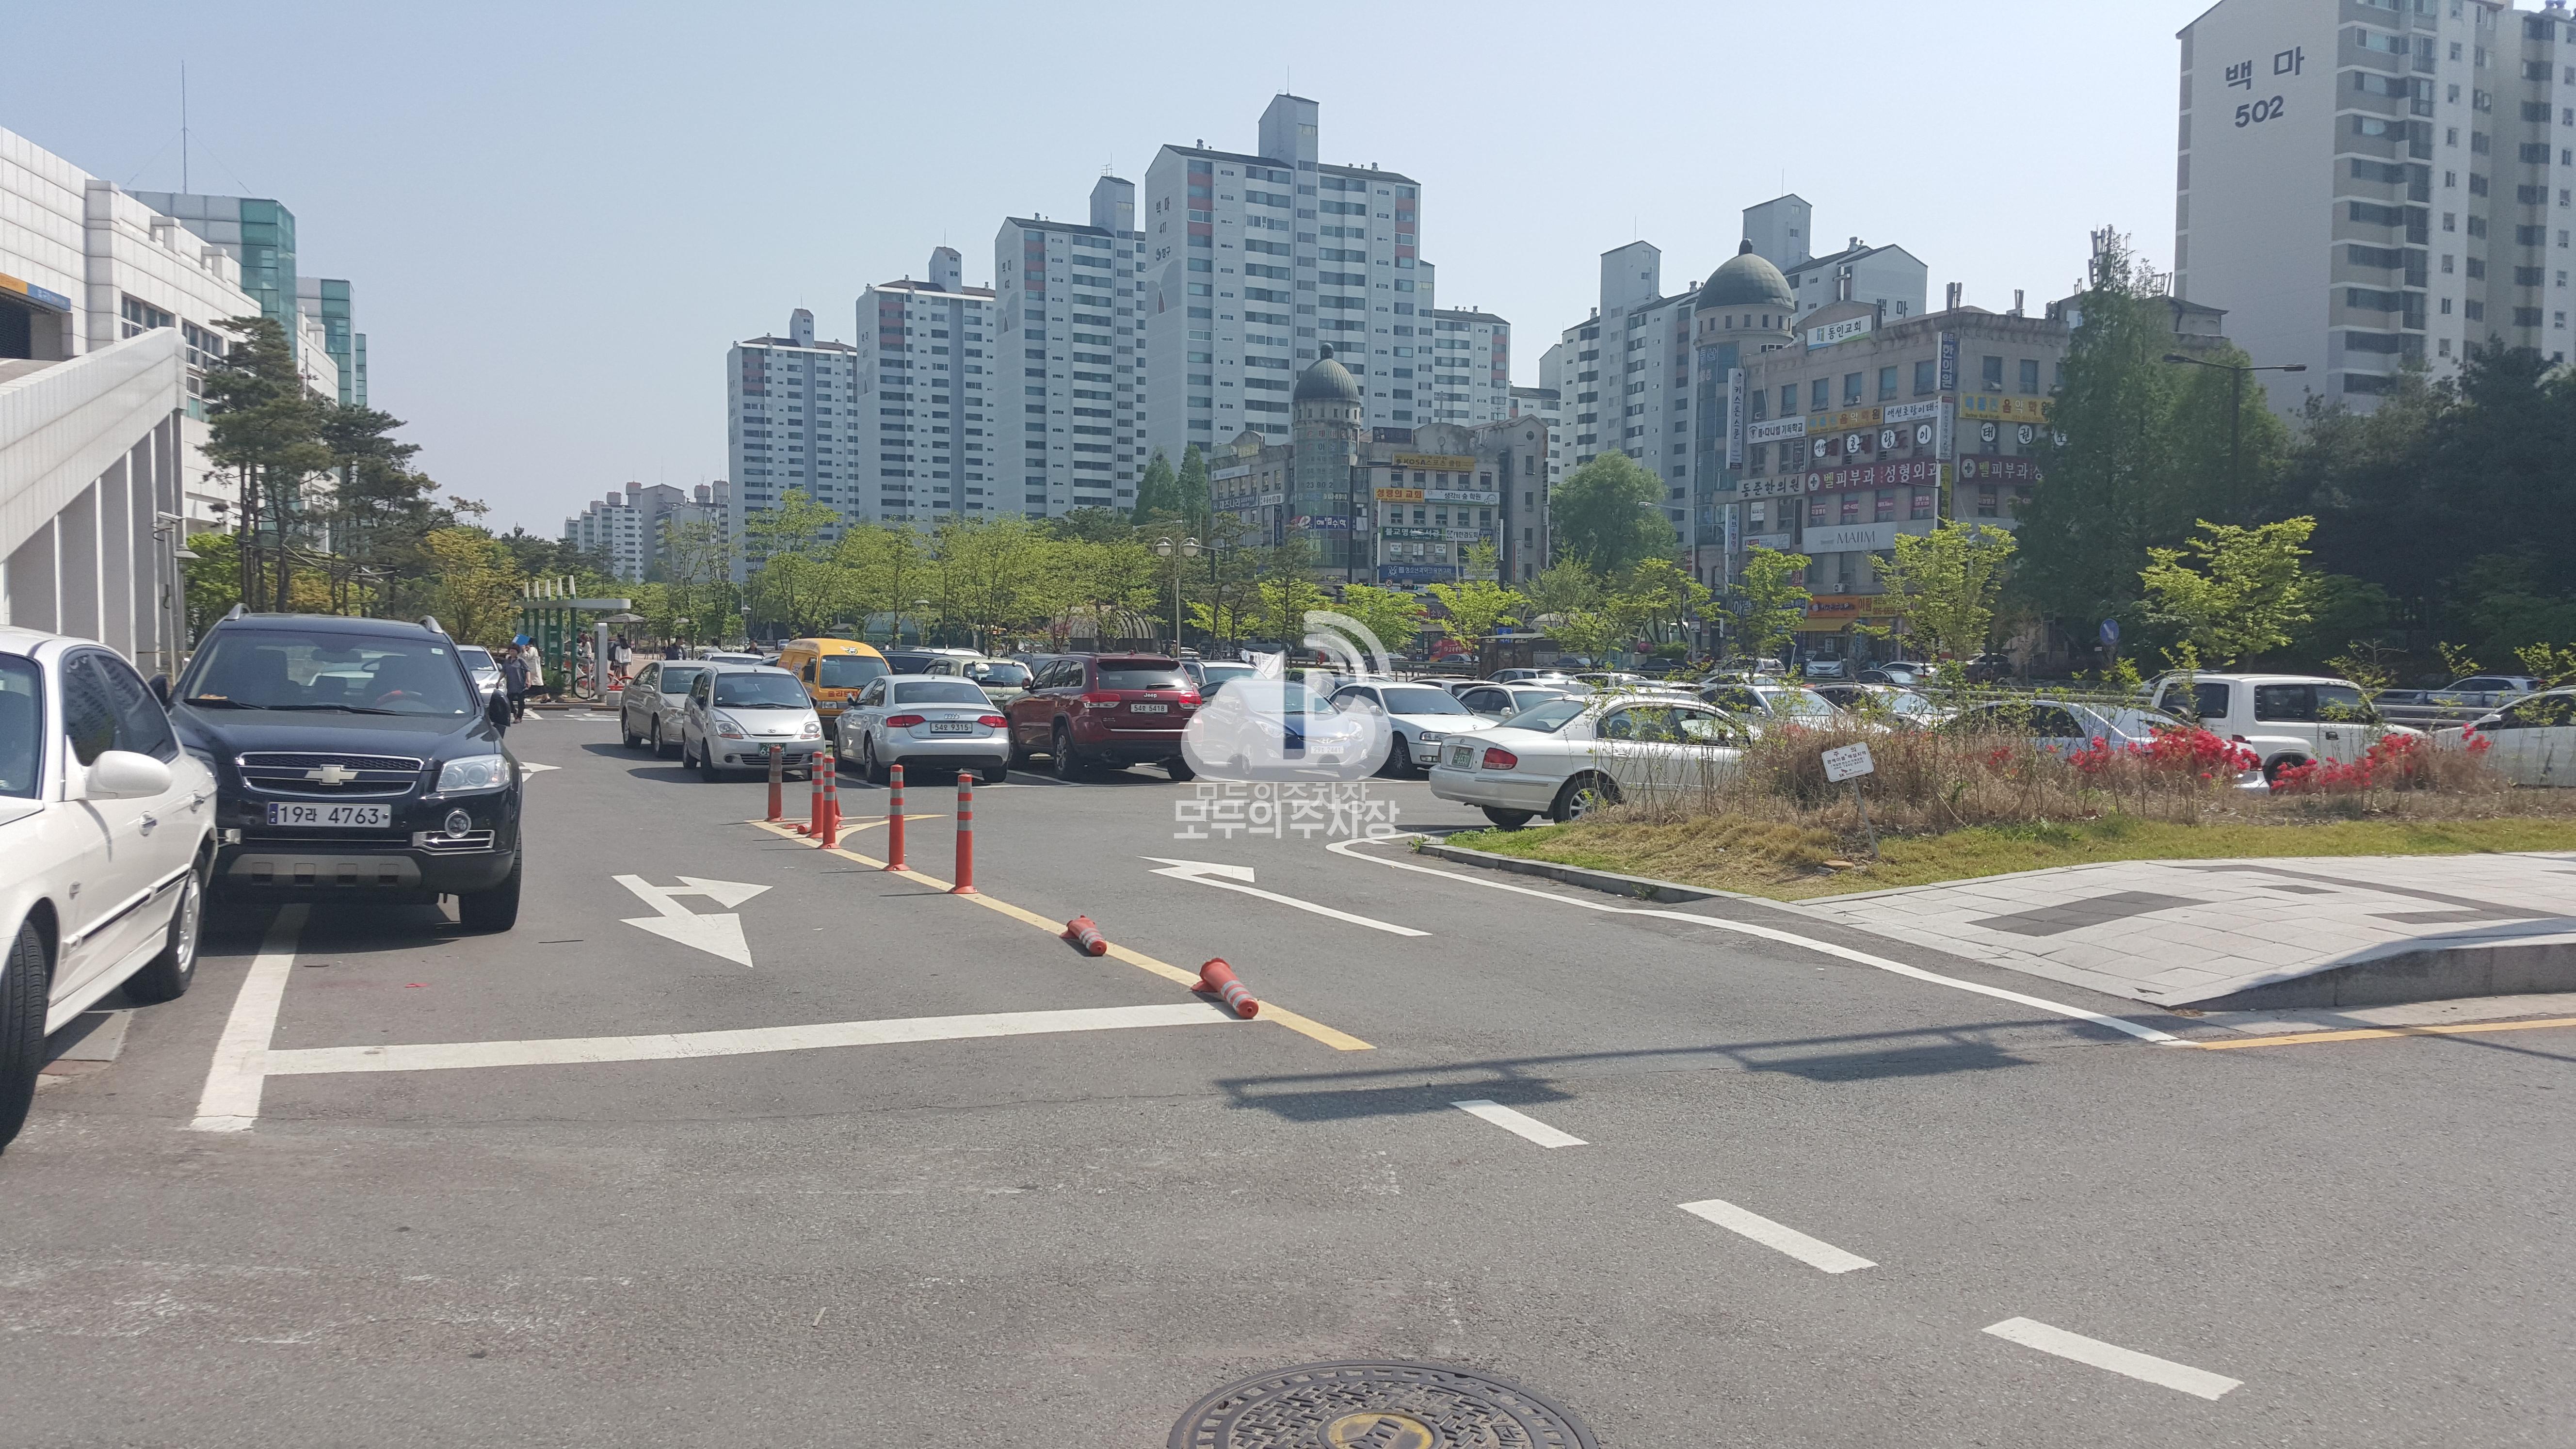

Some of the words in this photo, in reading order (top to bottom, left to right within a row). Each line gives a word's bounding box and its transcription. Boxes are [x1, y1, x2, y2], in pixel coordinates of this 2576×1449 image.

[2226, 60, 2252, 90] 백
[2274, 46, 2304, 76] 마
[2235, 96, 2284, 128] 502
[1828, 321, 1861, 340] 동인교회
[1942, 344, 1954, 388] 한의원
[1782, 422, 1803, 435] 기독학교
[1920, 428, 1928, 440] 이
[1982, 428, 1993, 437] 태
[2019, 428, 2029, 442] 권
[1823, 467, 1875, 489] 벨피부과
[1884, 461, 1938, 483] 성형외과
[1979, 461, 2028, 480] 벨피부과
[1377, 489, 1402, 498] 성령의
[1406, 490, 1422, 499] 교회
[1741, 476, 1800, 498] 동준한의원
[1837, 531, 1875, 544] MAIIM
[279, 806, 318, 823] 19라
[328, 807, 379, 824] 4763
